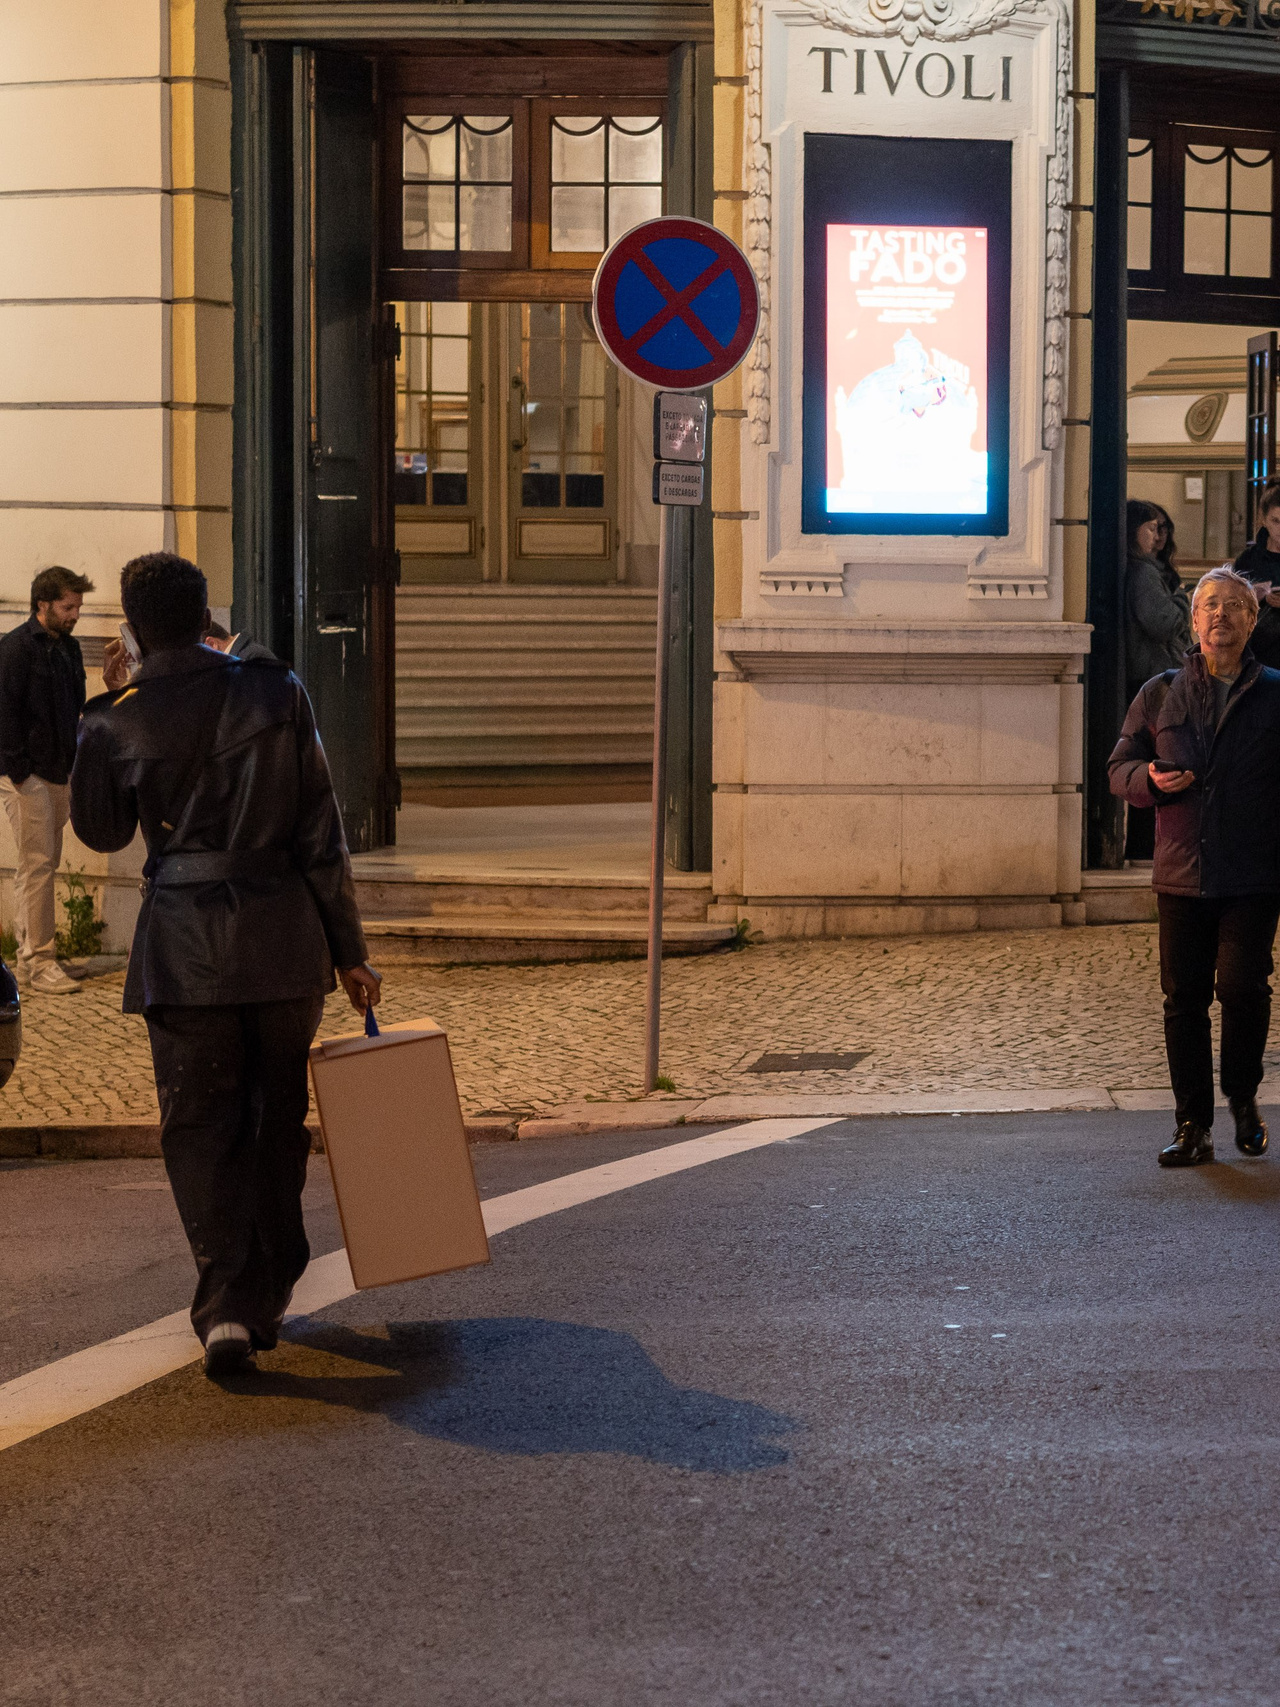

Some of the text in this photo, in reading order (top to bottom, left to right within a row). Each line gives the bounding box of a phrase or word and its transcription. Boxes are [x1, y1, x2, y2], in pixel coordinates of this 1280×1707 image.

[807, 46, 1013, 102] TIVOLI
[850, 230, 966, 255] TASTING
[850, 250, 966, 285] FADO
[662, 411, 703, 423] EXCETO TOADA
[661, 473, 700, 484] EXCETO CARGAS
[668, 487, 698, 497] DESCARGAS
